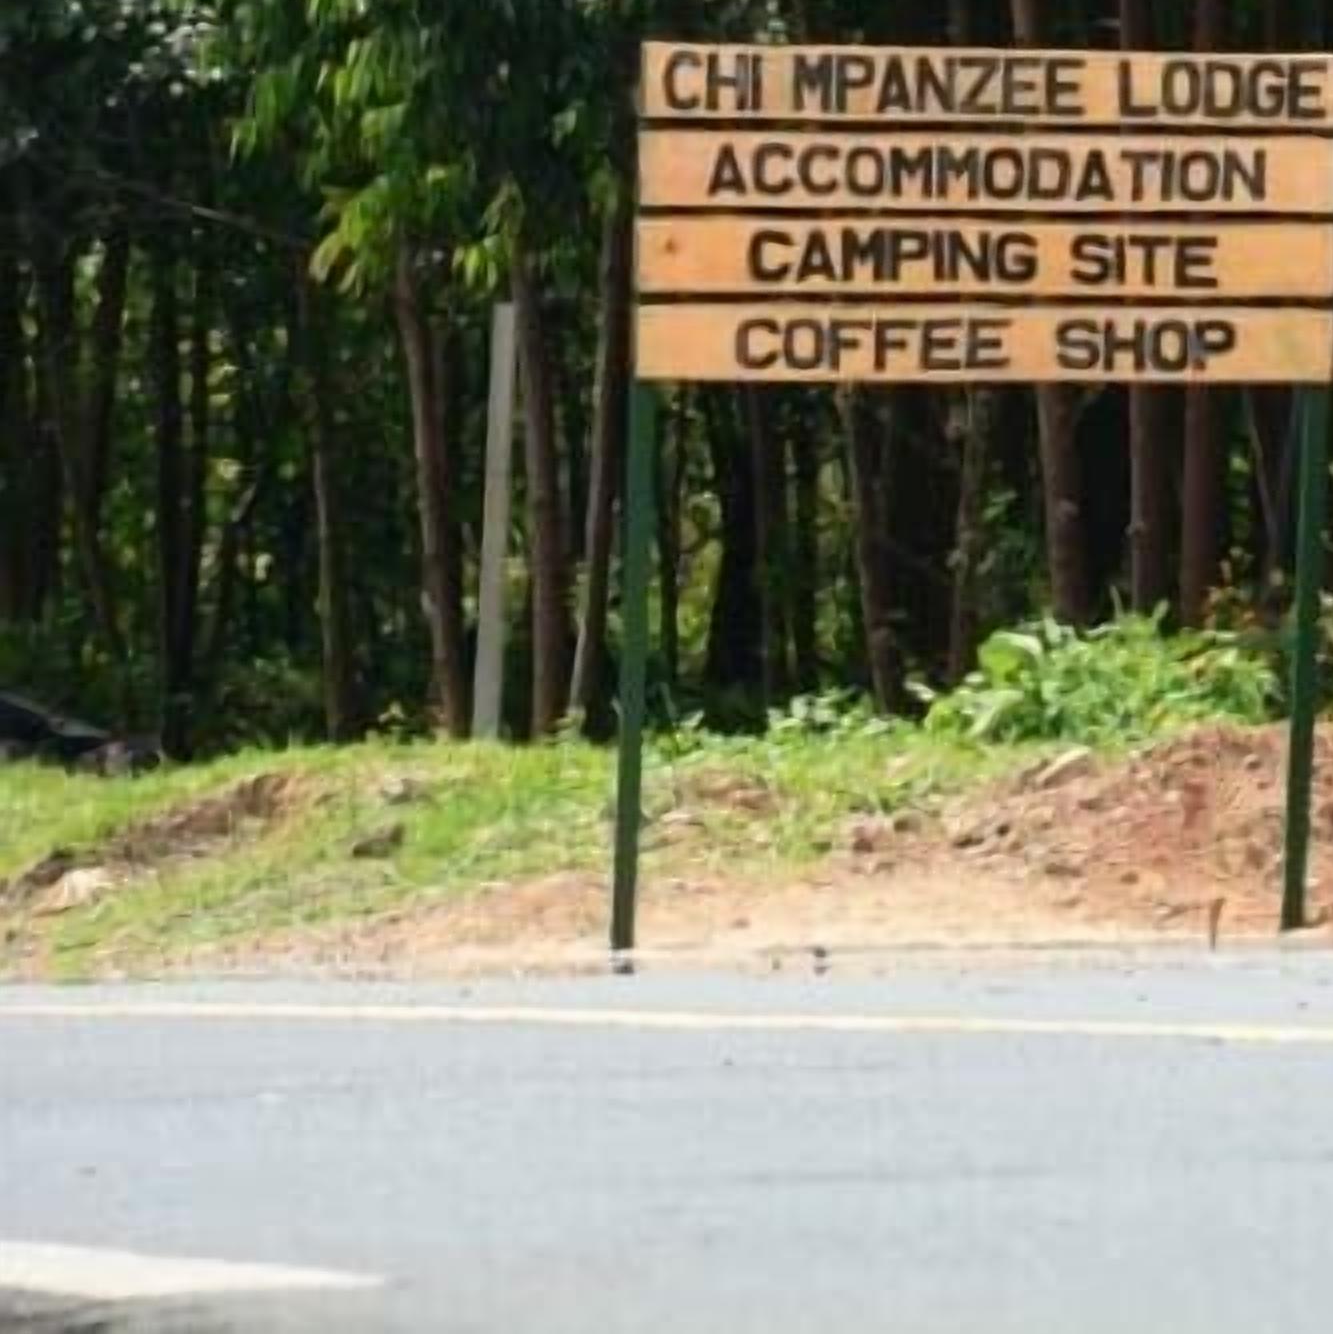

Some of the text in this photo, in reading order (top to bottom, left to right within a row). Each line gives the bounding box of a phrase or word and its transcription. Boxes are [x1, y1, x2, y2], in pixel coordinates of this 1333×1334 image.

[1118, 59, 1328, 119] LODGE
[707, 142, 1266, 202] ACCOMMODATION
[747, 229, 1219, 289] CAMPING SITE
[734, 316, 1236, 372] COFFEE SHOP
